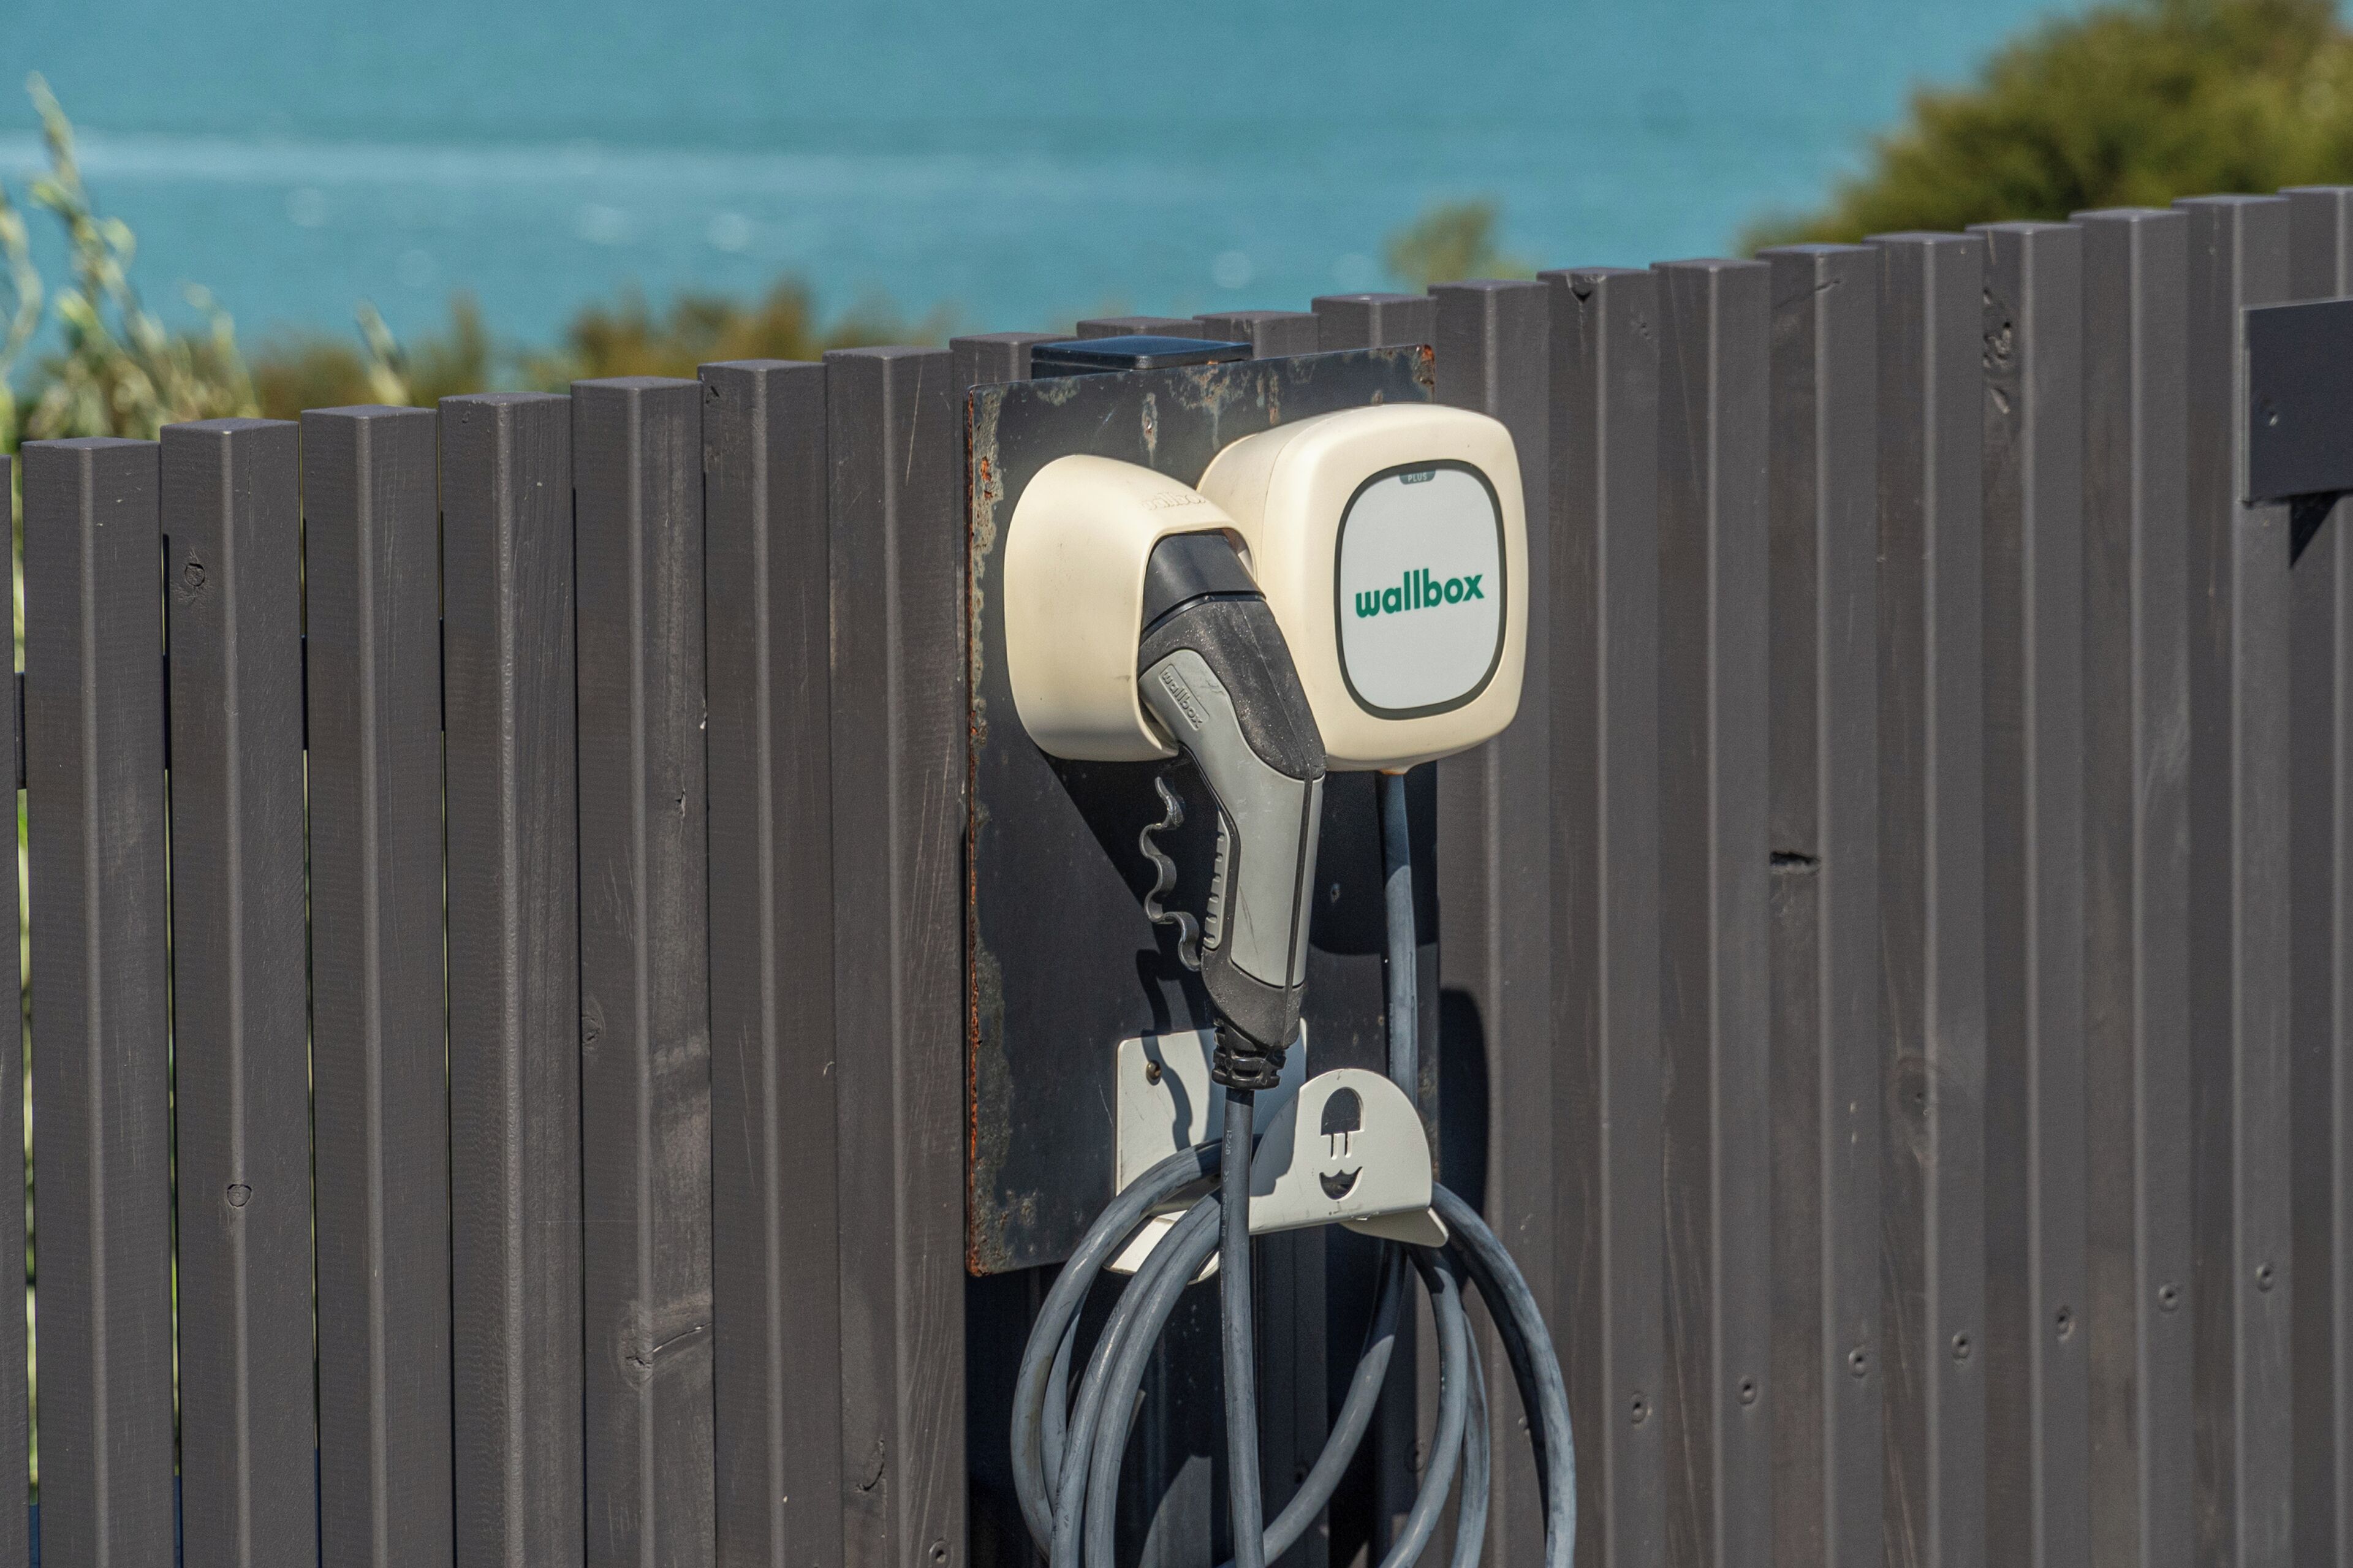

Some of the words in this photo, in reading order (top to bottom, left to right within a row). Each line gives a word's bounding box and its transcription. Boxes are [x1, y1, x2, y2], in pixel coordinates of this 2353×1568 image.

[1408, 472, 1427, 482] PLUS
[1355, 567, 1485, 618] wallbox
[1161, 670, 1203, 729] wallbox
